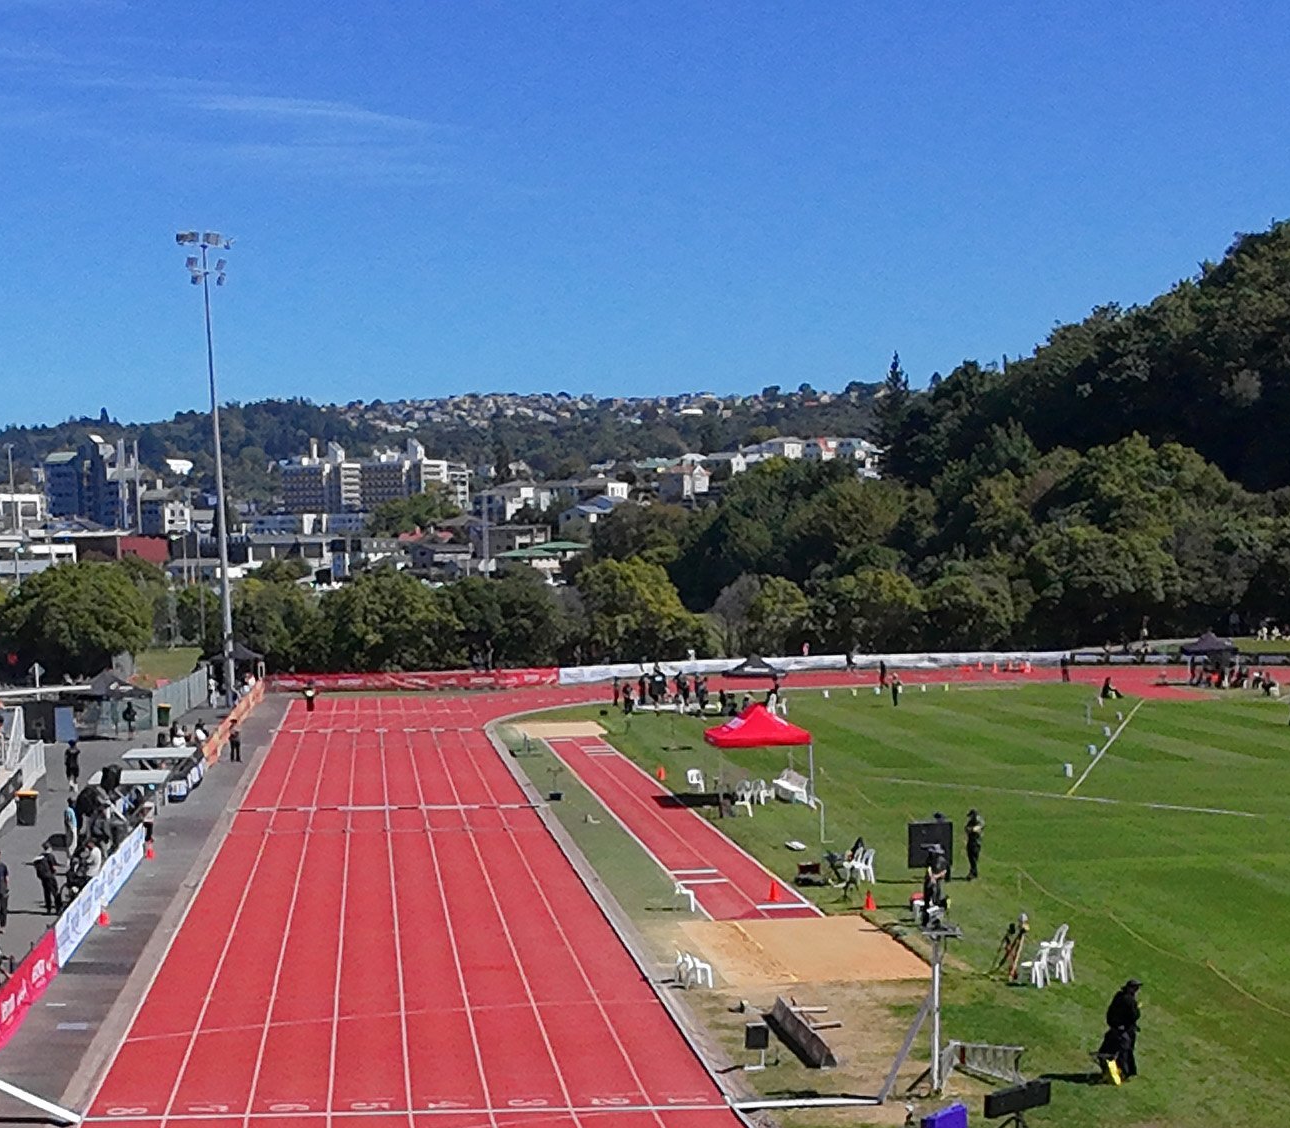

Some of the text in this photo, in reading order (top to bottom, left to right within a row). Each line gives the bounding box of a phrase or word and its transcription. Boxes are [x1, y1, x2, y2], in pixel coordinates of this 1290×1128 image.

[106, 1106, 148, 1116] 8
[188, 1104, 229, 1113] 7
[269, 1103, 310, 1112] 6
[350, 1102, 390, 1111] 5
[508, 1098, 549, 1107] 3
[591, 1097, 630, 1106] 2
